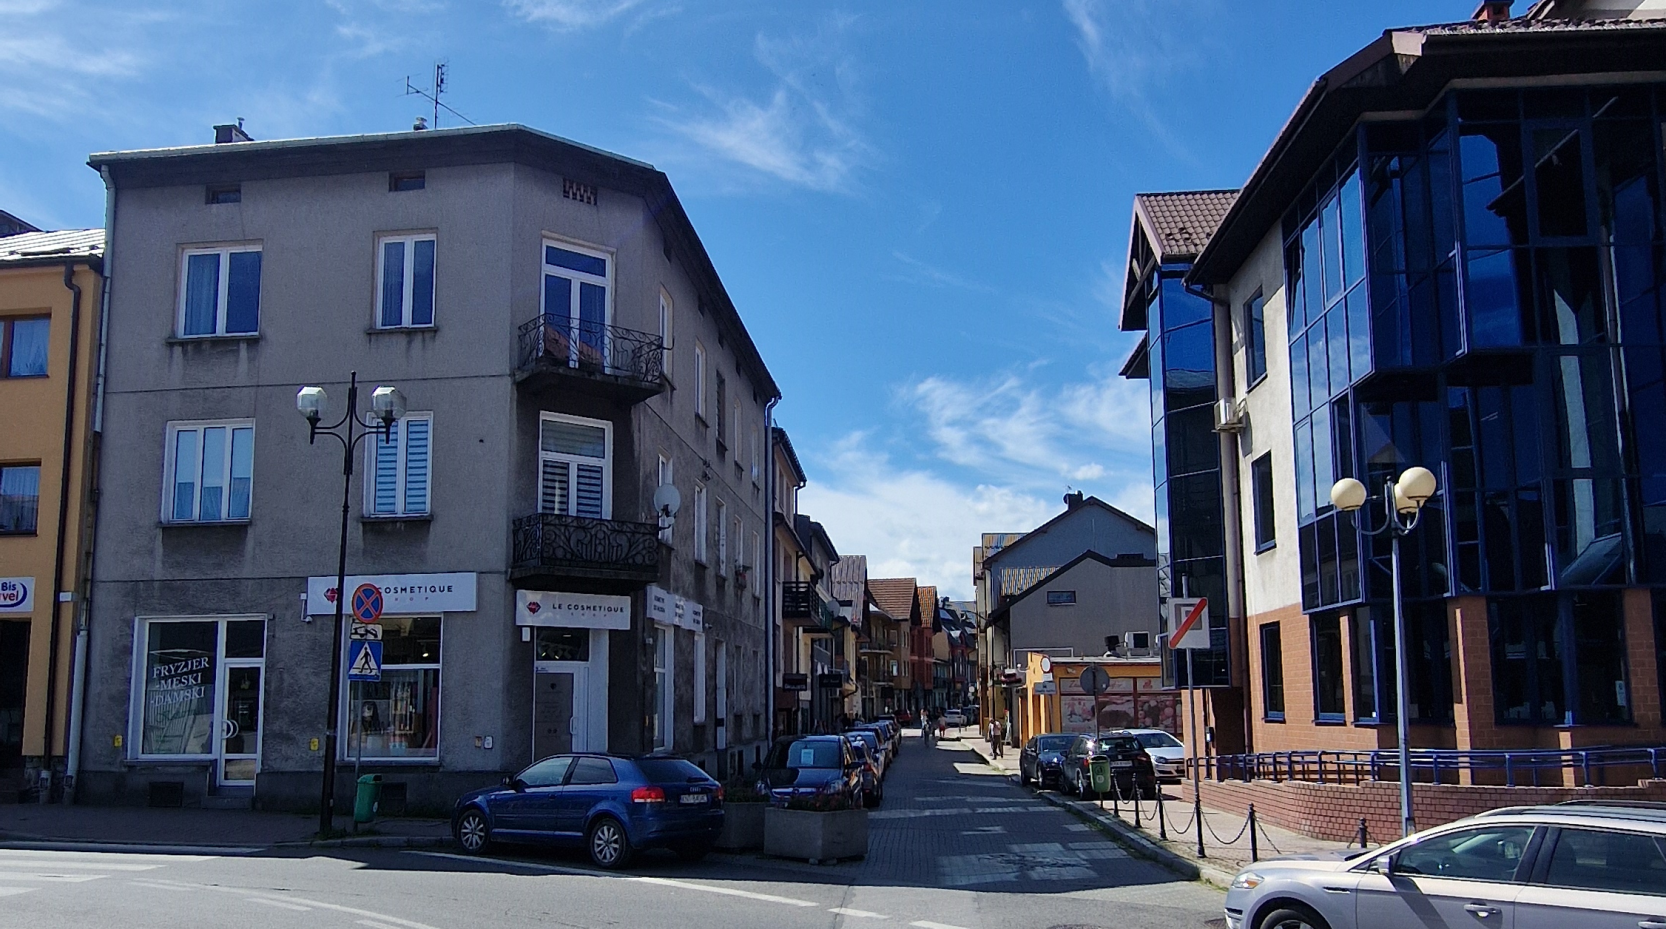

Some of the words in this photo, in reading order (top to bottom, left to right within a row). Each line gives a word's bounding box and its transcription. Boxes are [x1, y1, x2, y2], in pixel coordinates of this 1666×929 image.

[1, 581, 17, 591] Bis
[0, 590, 19, 602] vel
[567, 604, 625, 613] COSMETIQUE
[152, 656, 210, 679] FRYZJER
